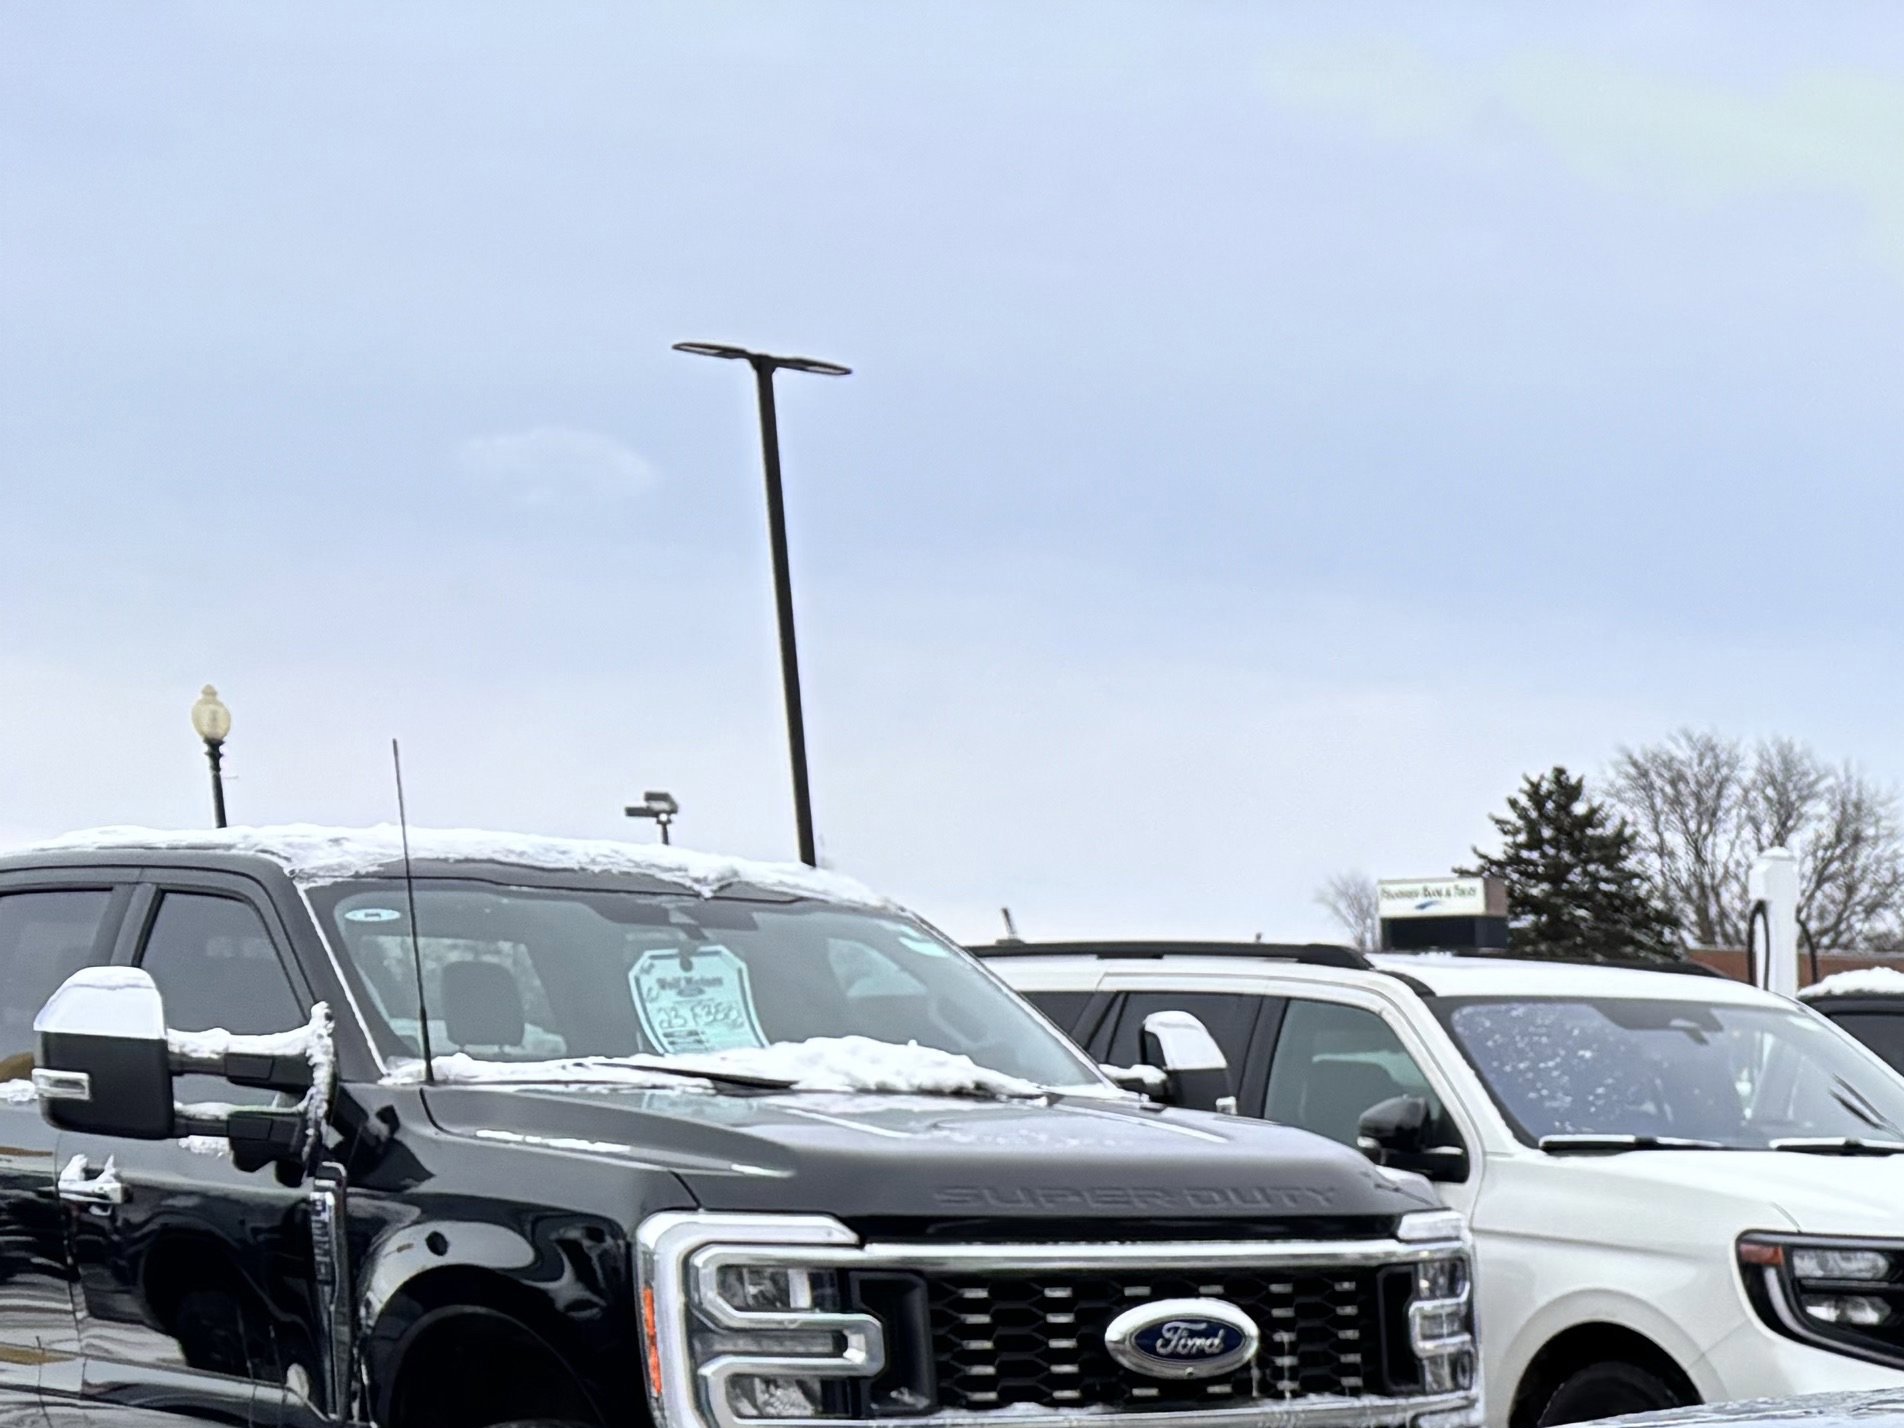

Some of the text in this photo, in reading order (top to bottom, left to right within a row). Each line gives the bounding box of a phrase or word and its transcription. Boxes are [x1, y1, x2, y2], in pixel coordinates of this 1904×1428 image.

[933, 1185, 1341, 1210] SUPER DUTY
[1156, 1321, 1225, 1356] Ford
